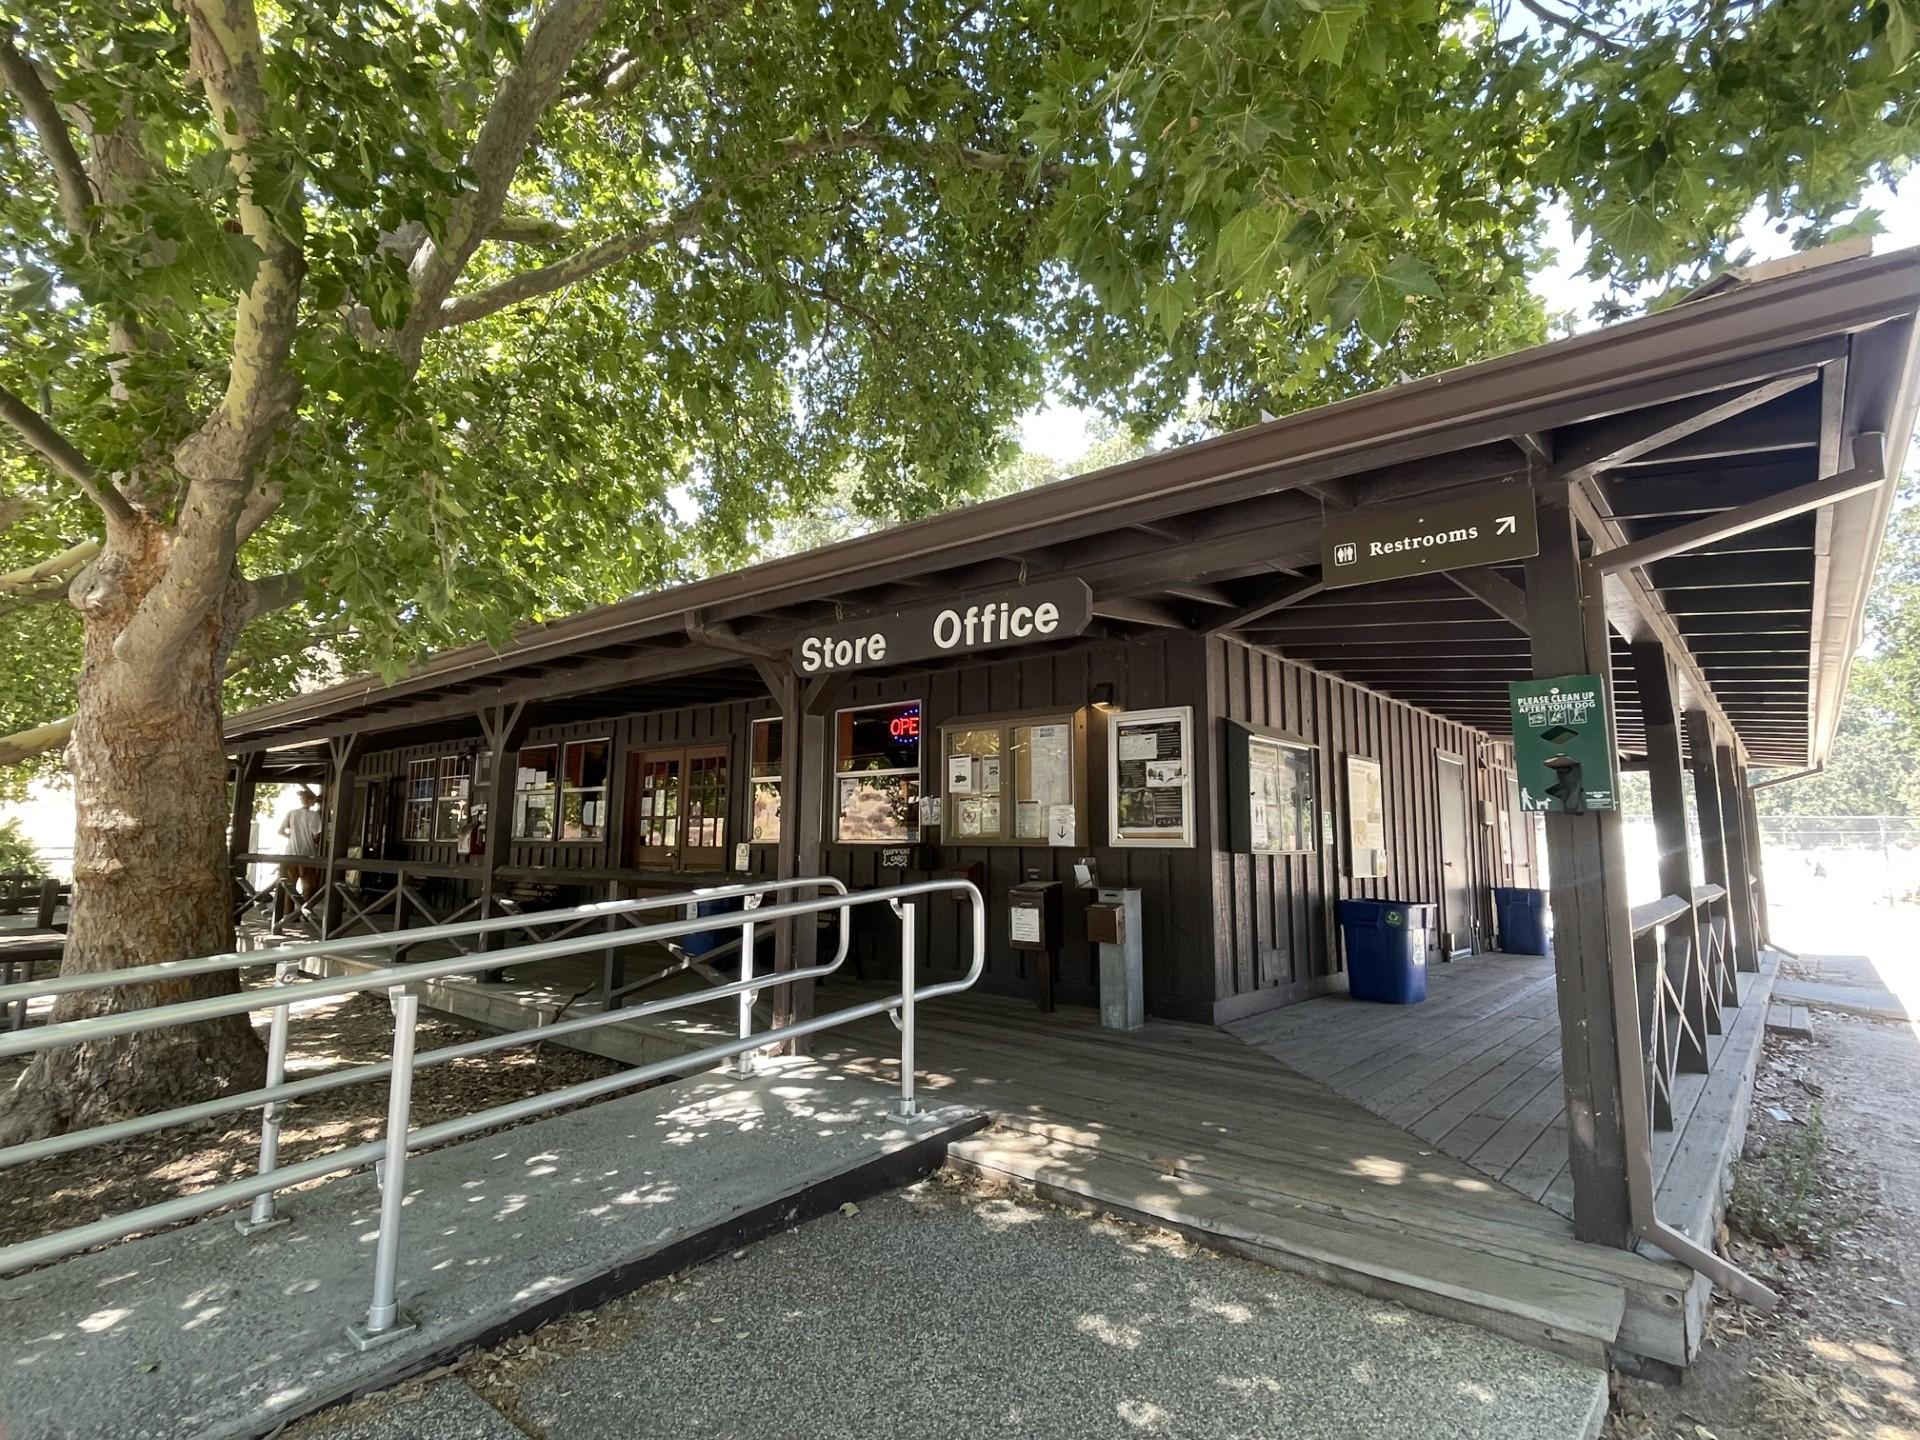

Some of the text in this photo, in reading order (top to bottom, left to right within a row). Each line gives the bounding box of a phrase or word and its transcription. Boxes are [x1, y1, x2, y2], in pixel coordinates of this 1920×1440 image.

[1369, 526, 1479, 557] Restrooms
[801, 602, 1060, 672] Store Office
[1517, 691, 1595, 706] PLEASE CLEAN UP
[1519, 701, 1596, 713] AFTER YOUR DOG
